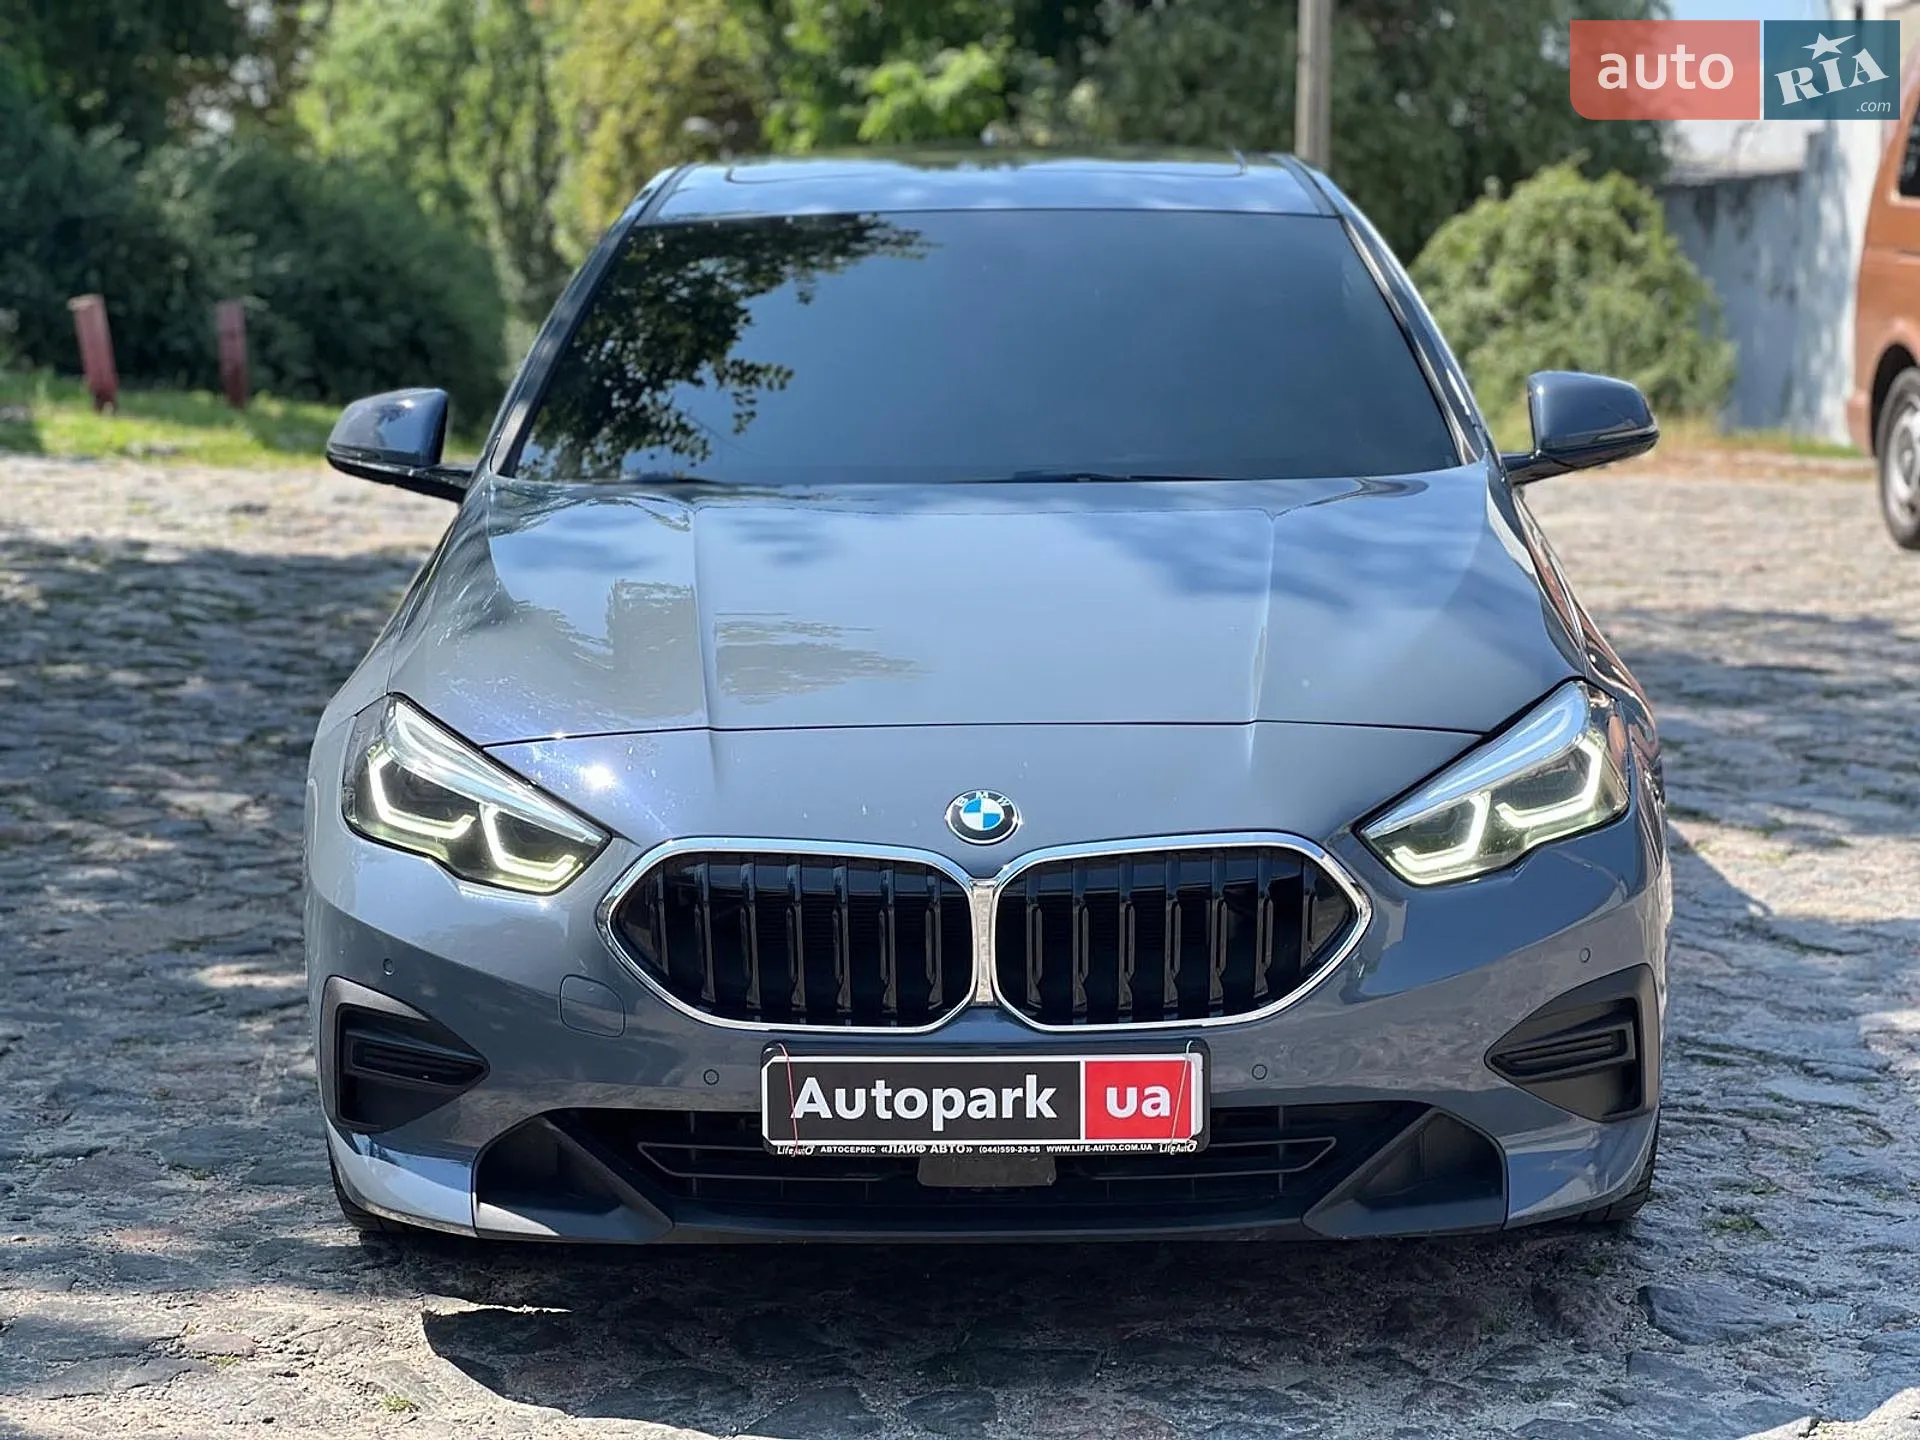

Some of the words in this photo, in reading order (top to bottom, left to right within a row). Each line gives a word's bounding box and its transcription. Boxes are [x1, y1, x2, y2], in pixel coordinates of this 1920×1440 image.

[954, 791, 1010, 807] BMW
[791, 1075, 1057, 1132] Autopark
[1106, 1084, 1170, 1118] ua
[1046, 1144, 1153, 1153] WWW.LIFE-AUTO.COM.UA
